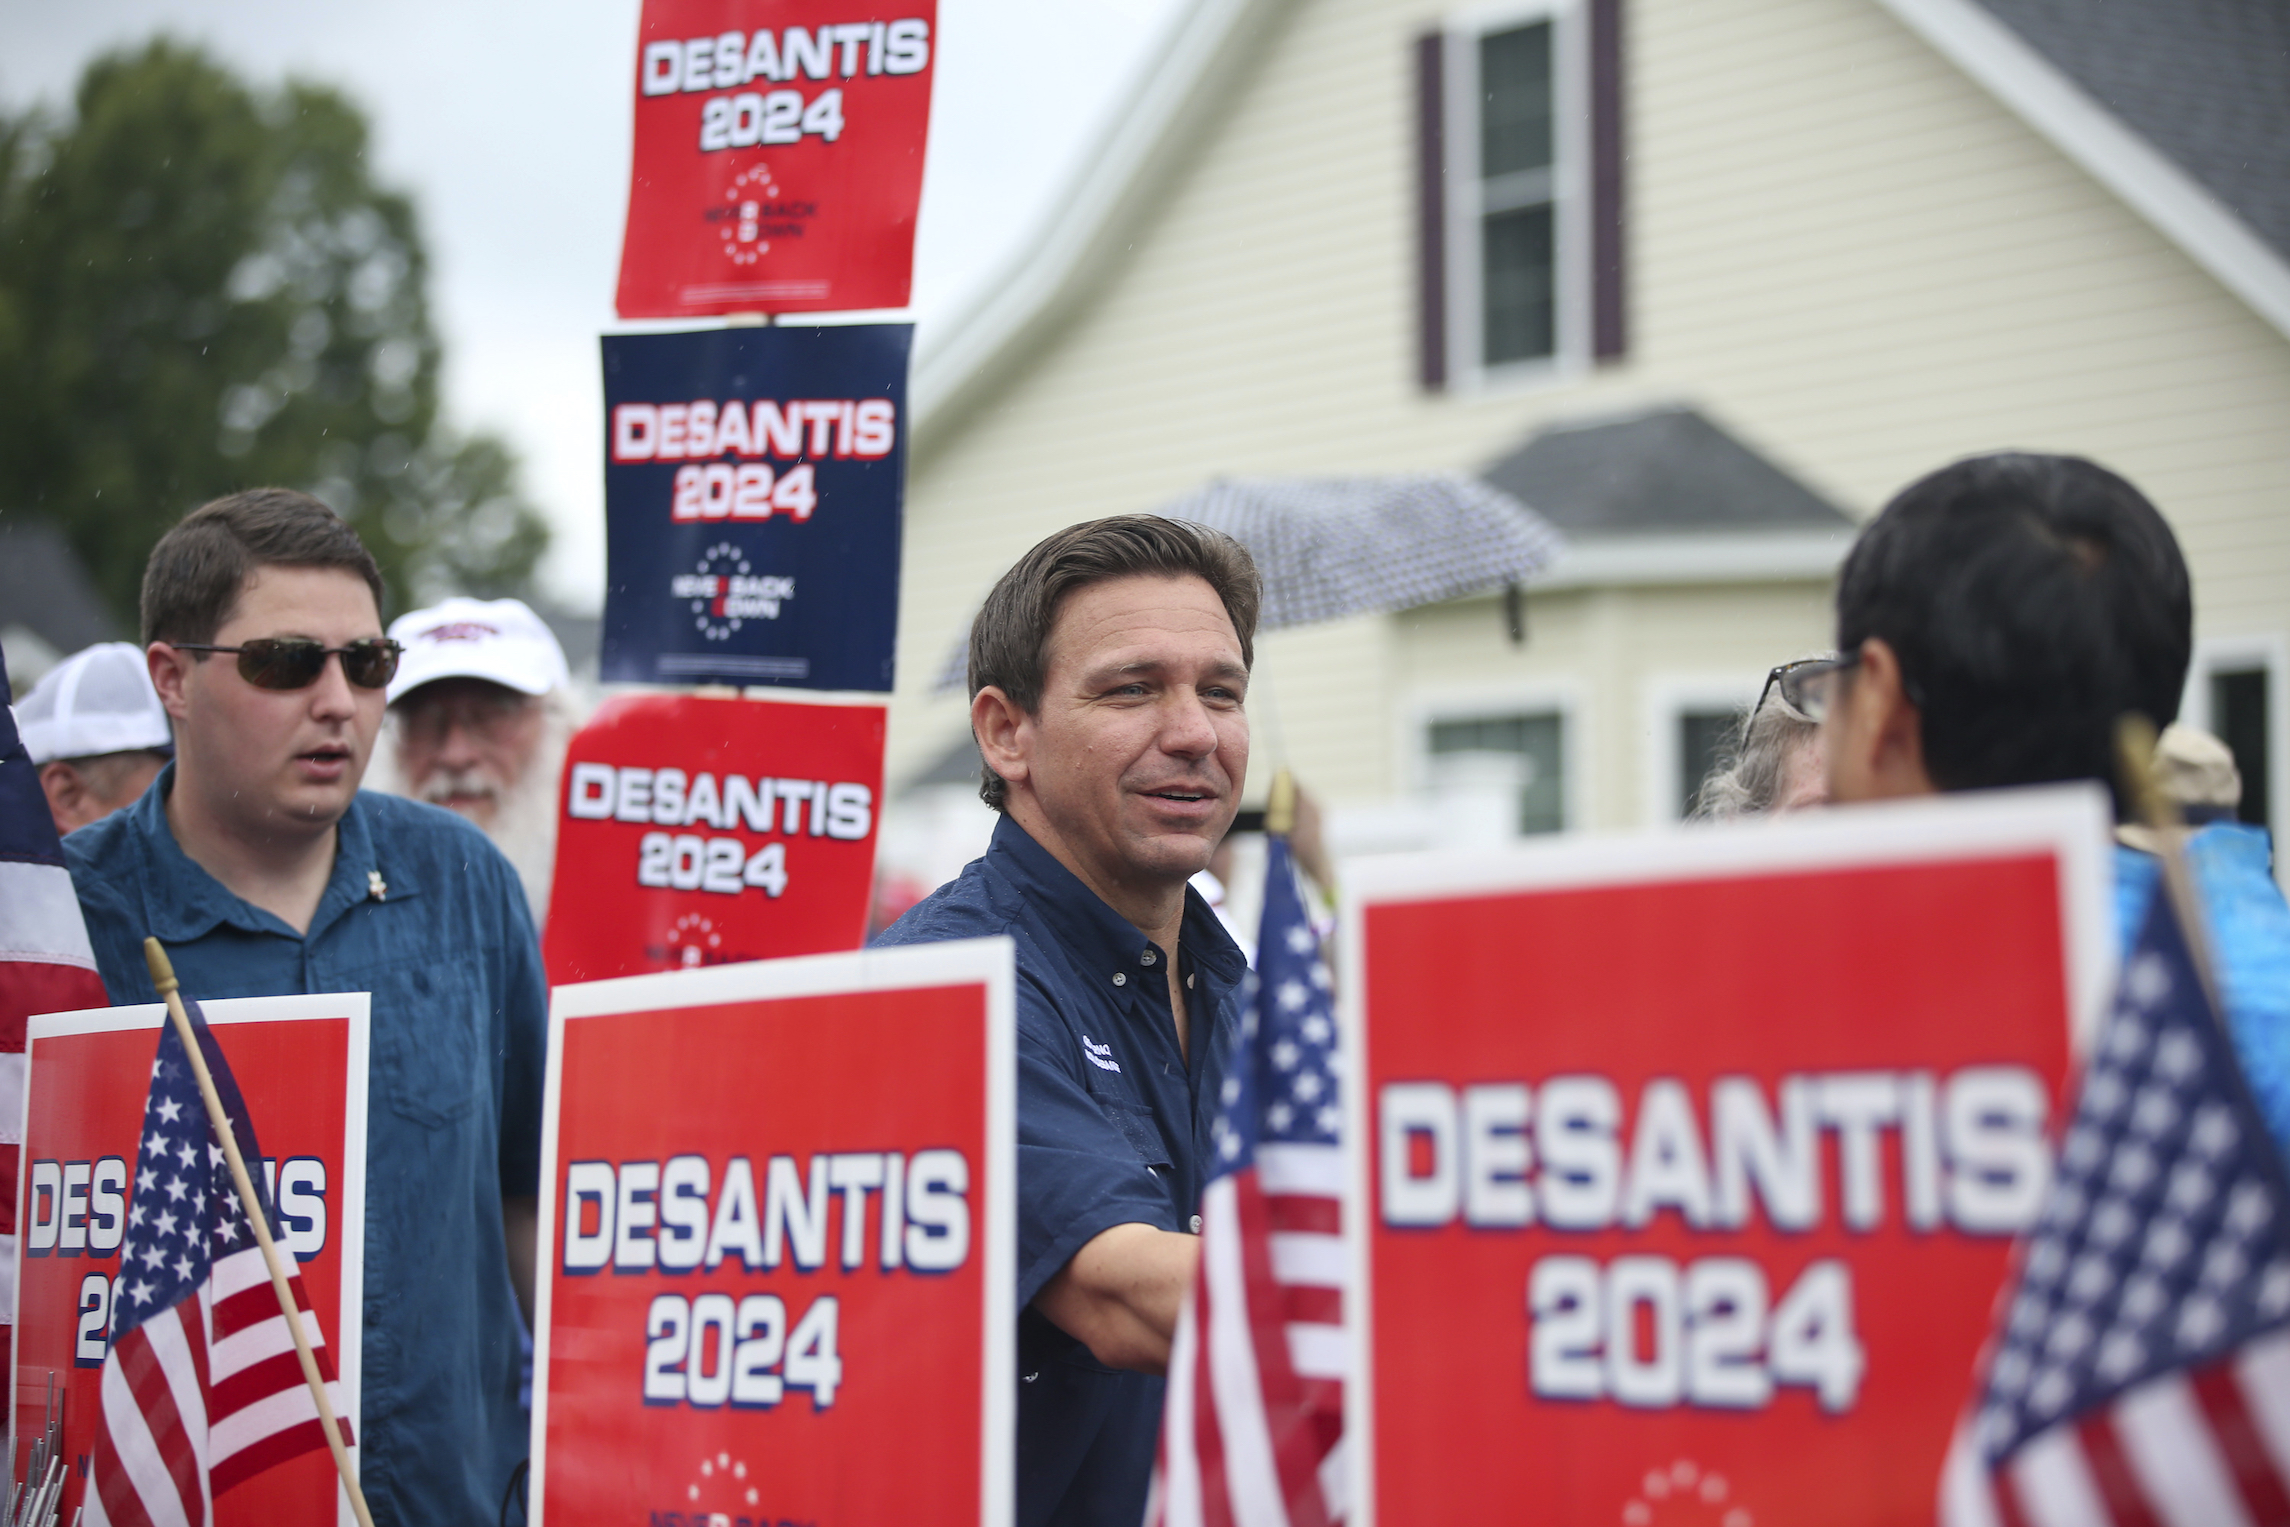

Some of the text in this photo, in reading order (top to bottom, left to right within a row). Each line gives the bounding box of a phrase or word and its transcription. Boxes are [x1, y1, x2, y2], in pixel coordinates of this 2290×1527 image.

[640, 18, 930, 97] DESANTIS
[699, 87, 846, 153] 2024
[612, 398, 896, 465] DESANTIS
[671, 462, 819, 524] 2024
[568, 761, 873, 841] DESANTIS
[637, 831, 789, 899] 2024
[1378, 1062, 2058, 1237] DESANTIS
[26, 1155, 327, 1262] DESS
[562, 1148, 971, 1278] DESANTIS
[642, 1293, 843, 1414] 2024
[1527, 1253, 1866, 1417] 2024
